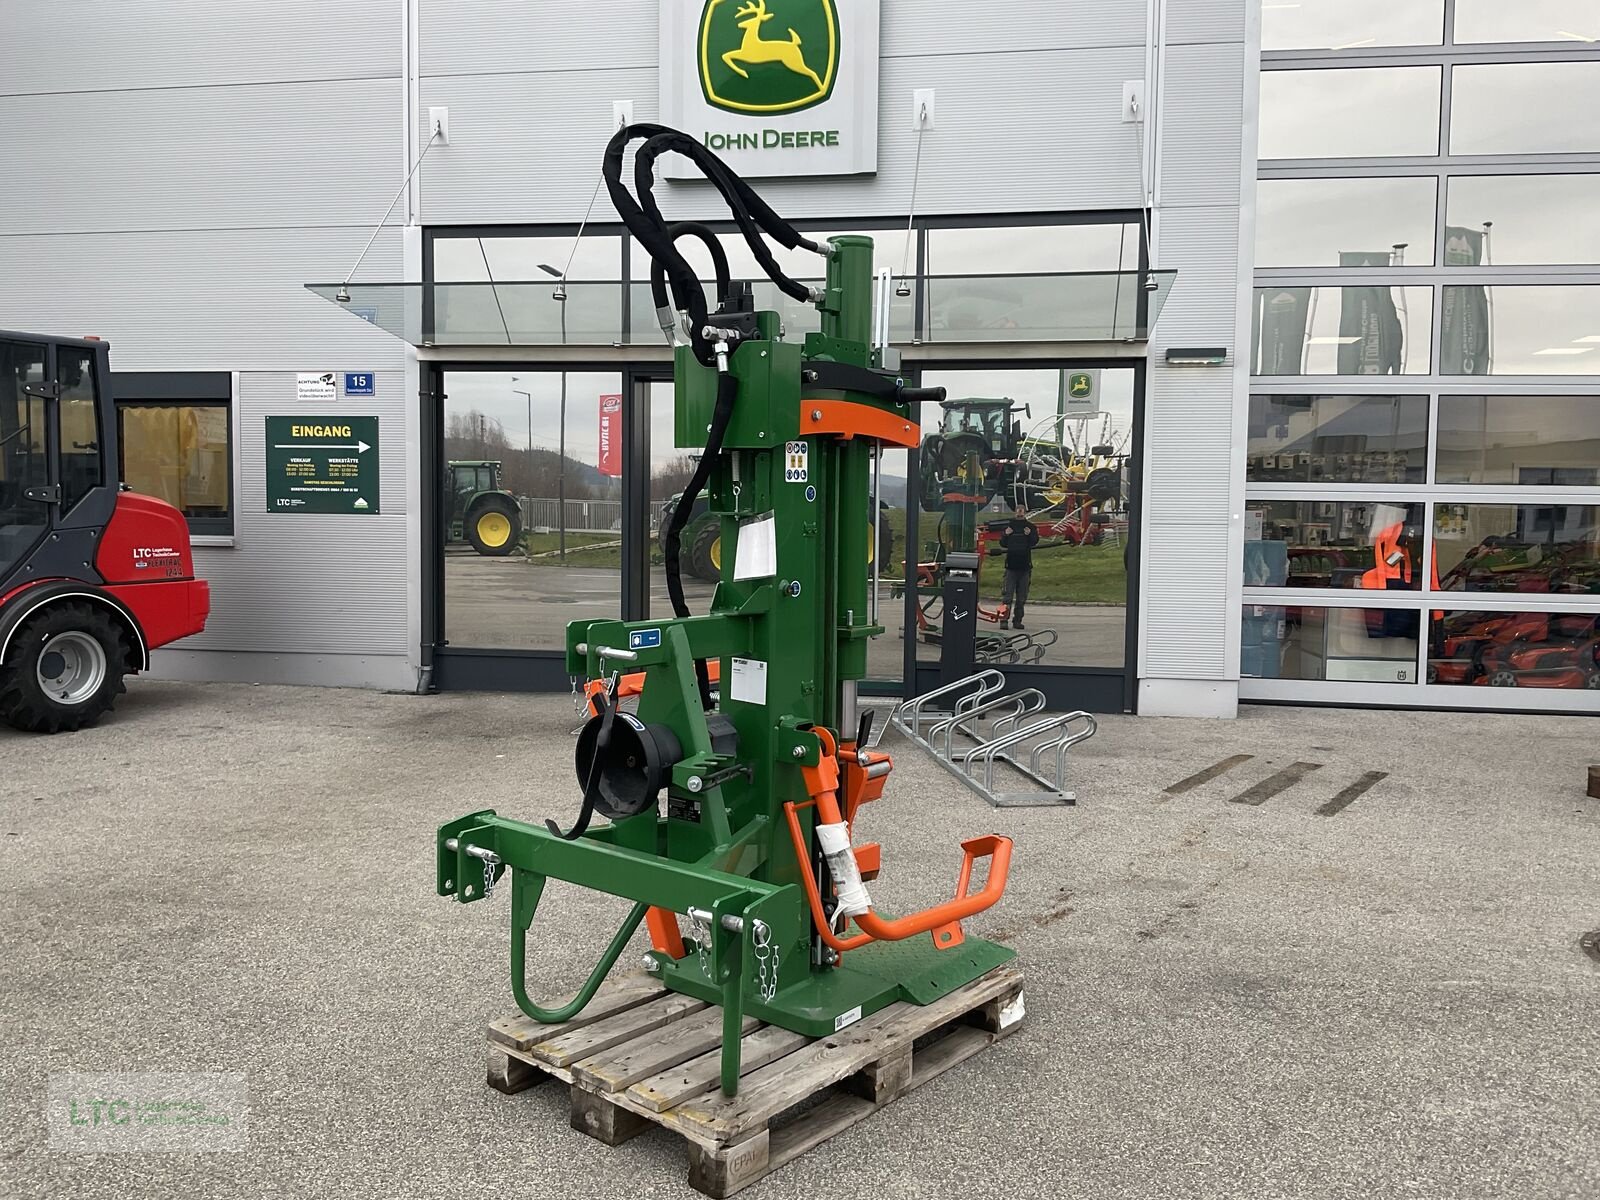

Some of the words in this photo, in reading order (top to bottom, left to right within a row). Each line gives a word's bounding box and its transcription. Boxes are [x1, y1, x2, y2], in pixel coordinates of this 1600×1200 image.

[704, 131, 758, 150] JOHN
[762, 129, 839, 149] DEERE
[352, 376, 366, 387] 15
[292, 425, 352, 437] EINGANG
[276, 498, 290, 506] LTC
[133, 548, 152, 558] LTC
